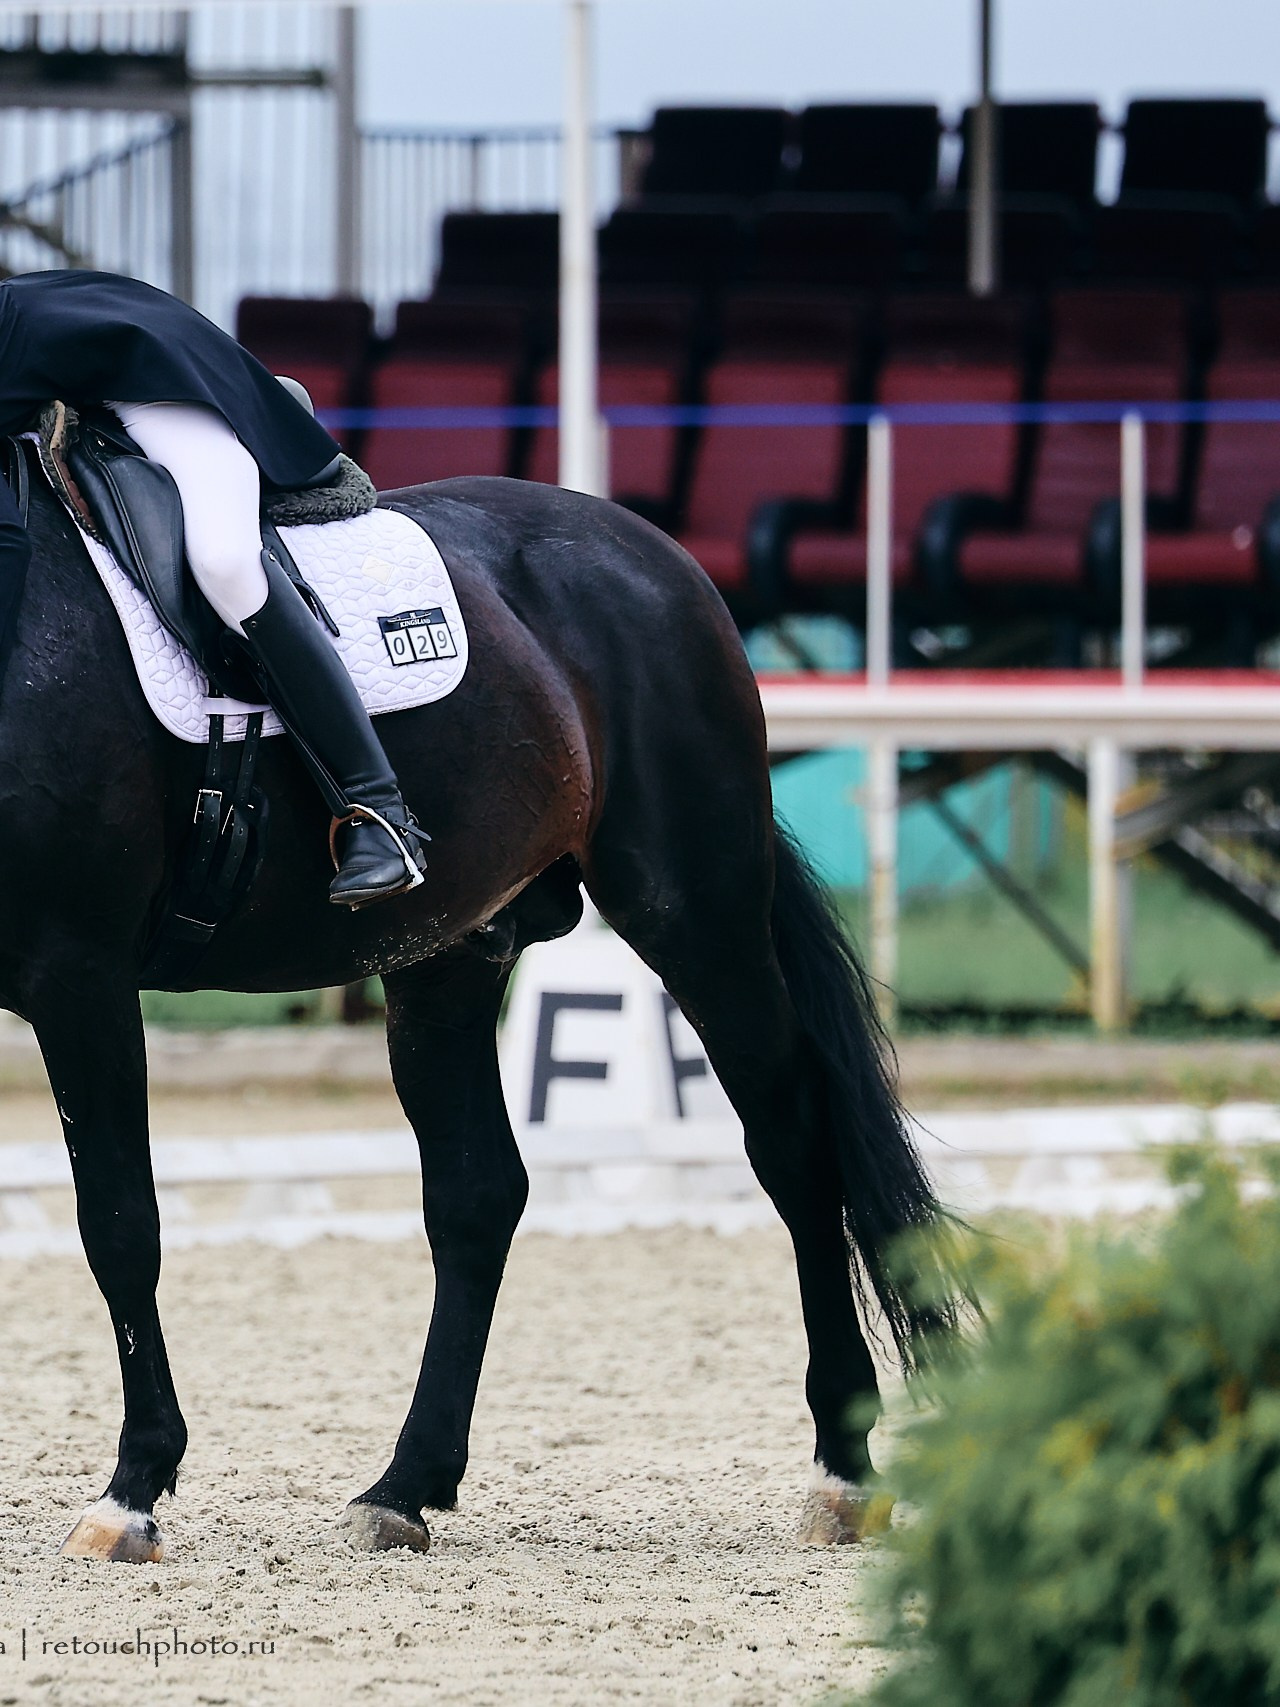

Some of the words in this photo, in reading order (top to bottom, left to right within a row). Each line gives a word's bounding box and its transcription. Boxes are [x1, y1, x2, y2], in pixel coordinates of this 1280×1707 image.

[400, 618, 431, 628] KINGSLAND
[393, 630, 447, 655] 029
[529, 992, 622, 1122] F
